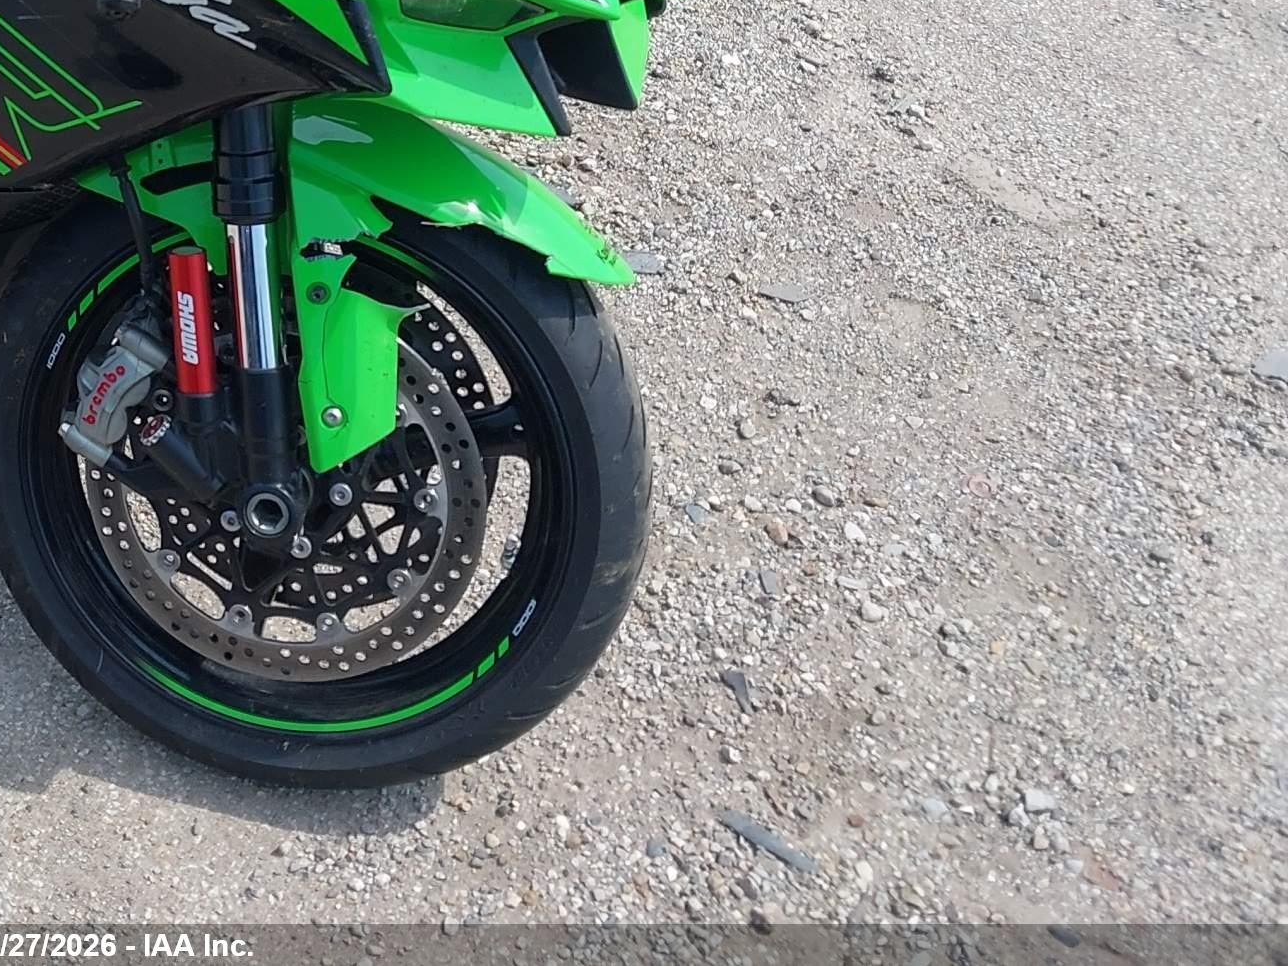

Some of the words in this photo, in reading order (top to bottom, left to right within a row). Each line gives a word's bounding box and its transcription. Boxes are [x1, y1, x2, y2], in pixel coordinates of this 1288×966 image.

[46, 331, 67, 370] 1000
[176, 290, 199, 366] SHOWA
[82, 364, 127, 426] brembo
